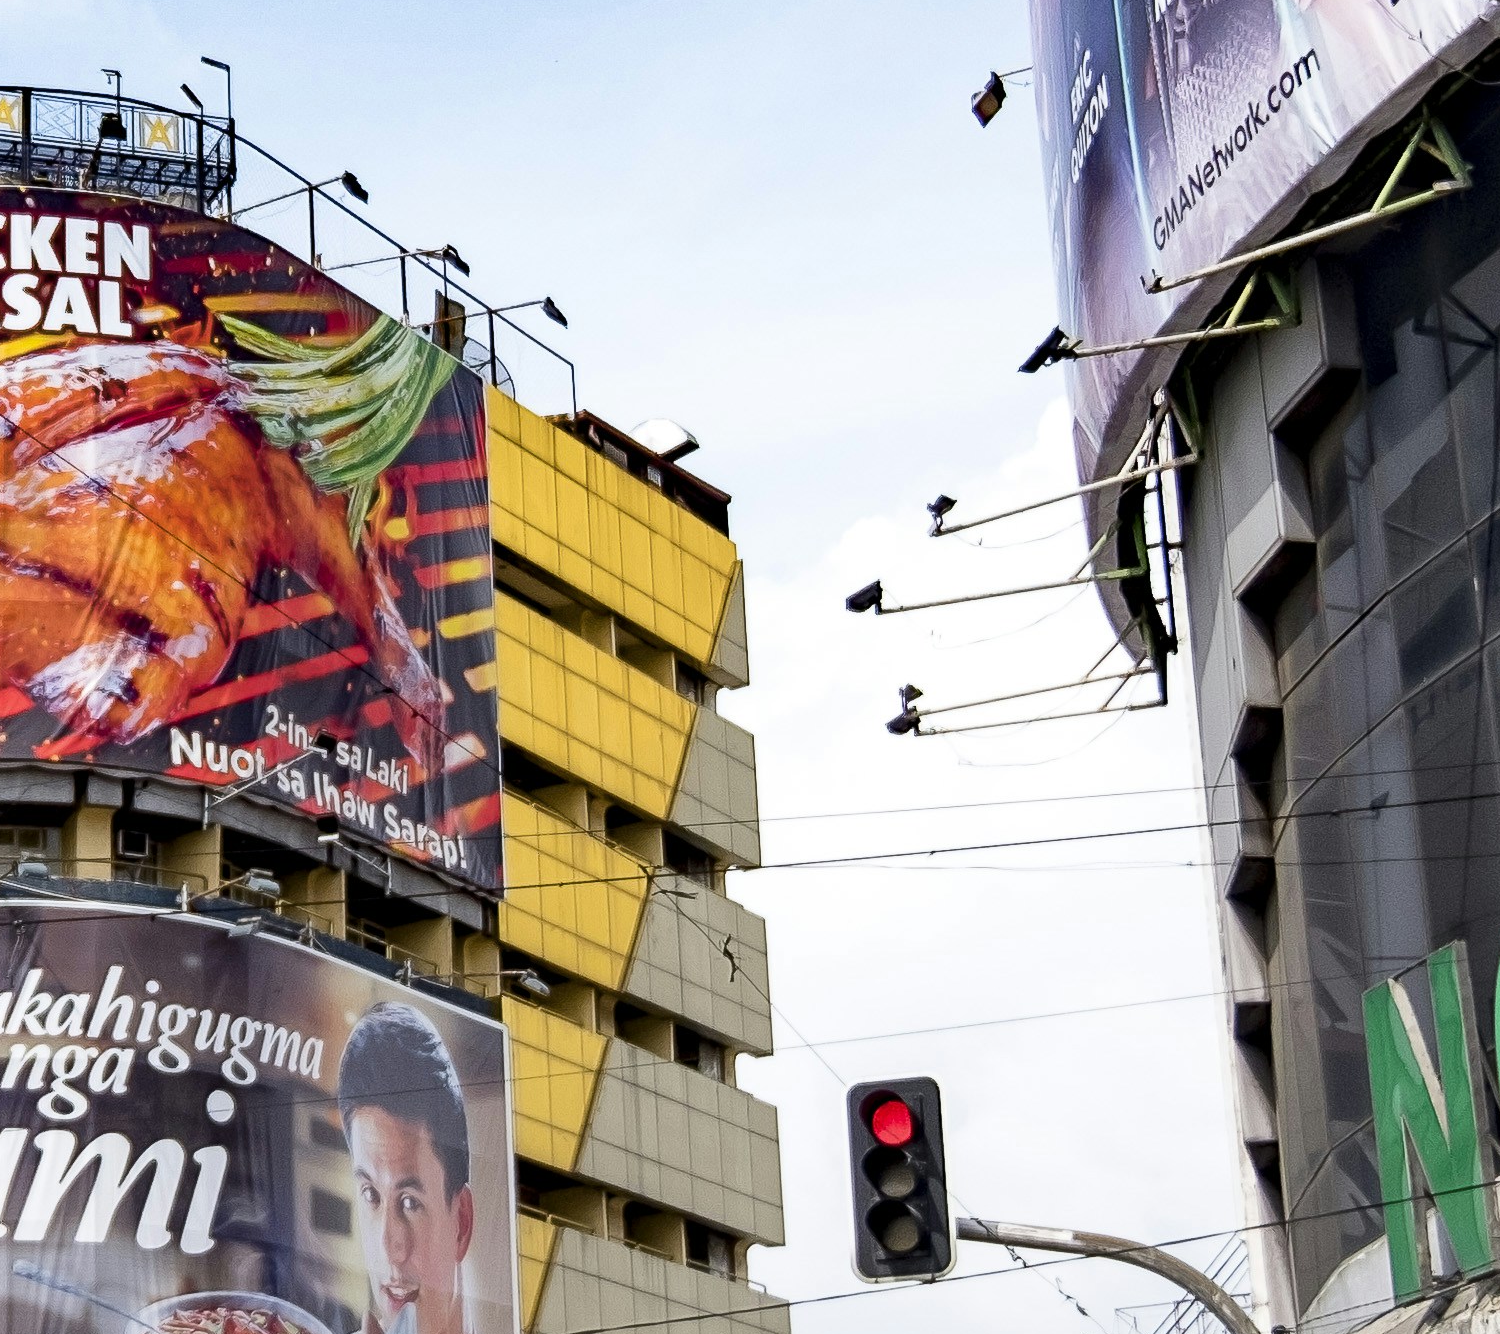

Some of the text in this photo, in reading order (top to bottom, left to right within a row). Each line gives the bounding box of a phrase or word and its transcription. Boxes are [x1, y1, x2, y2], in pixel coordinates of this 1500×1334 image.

[1070, 47, 1093, 125] ERIC
[1071, 72, 1109, 185] QUIZON
[1152, 47, 1321, 252] GMANetwork.com
[169, 726, 468, 870] Nuot sa Ihaw Sarap!
[336, 739, 362, 772] sa
[366, 747, 409, 795] Laki
[0, 1039, 130, 1120] nga
